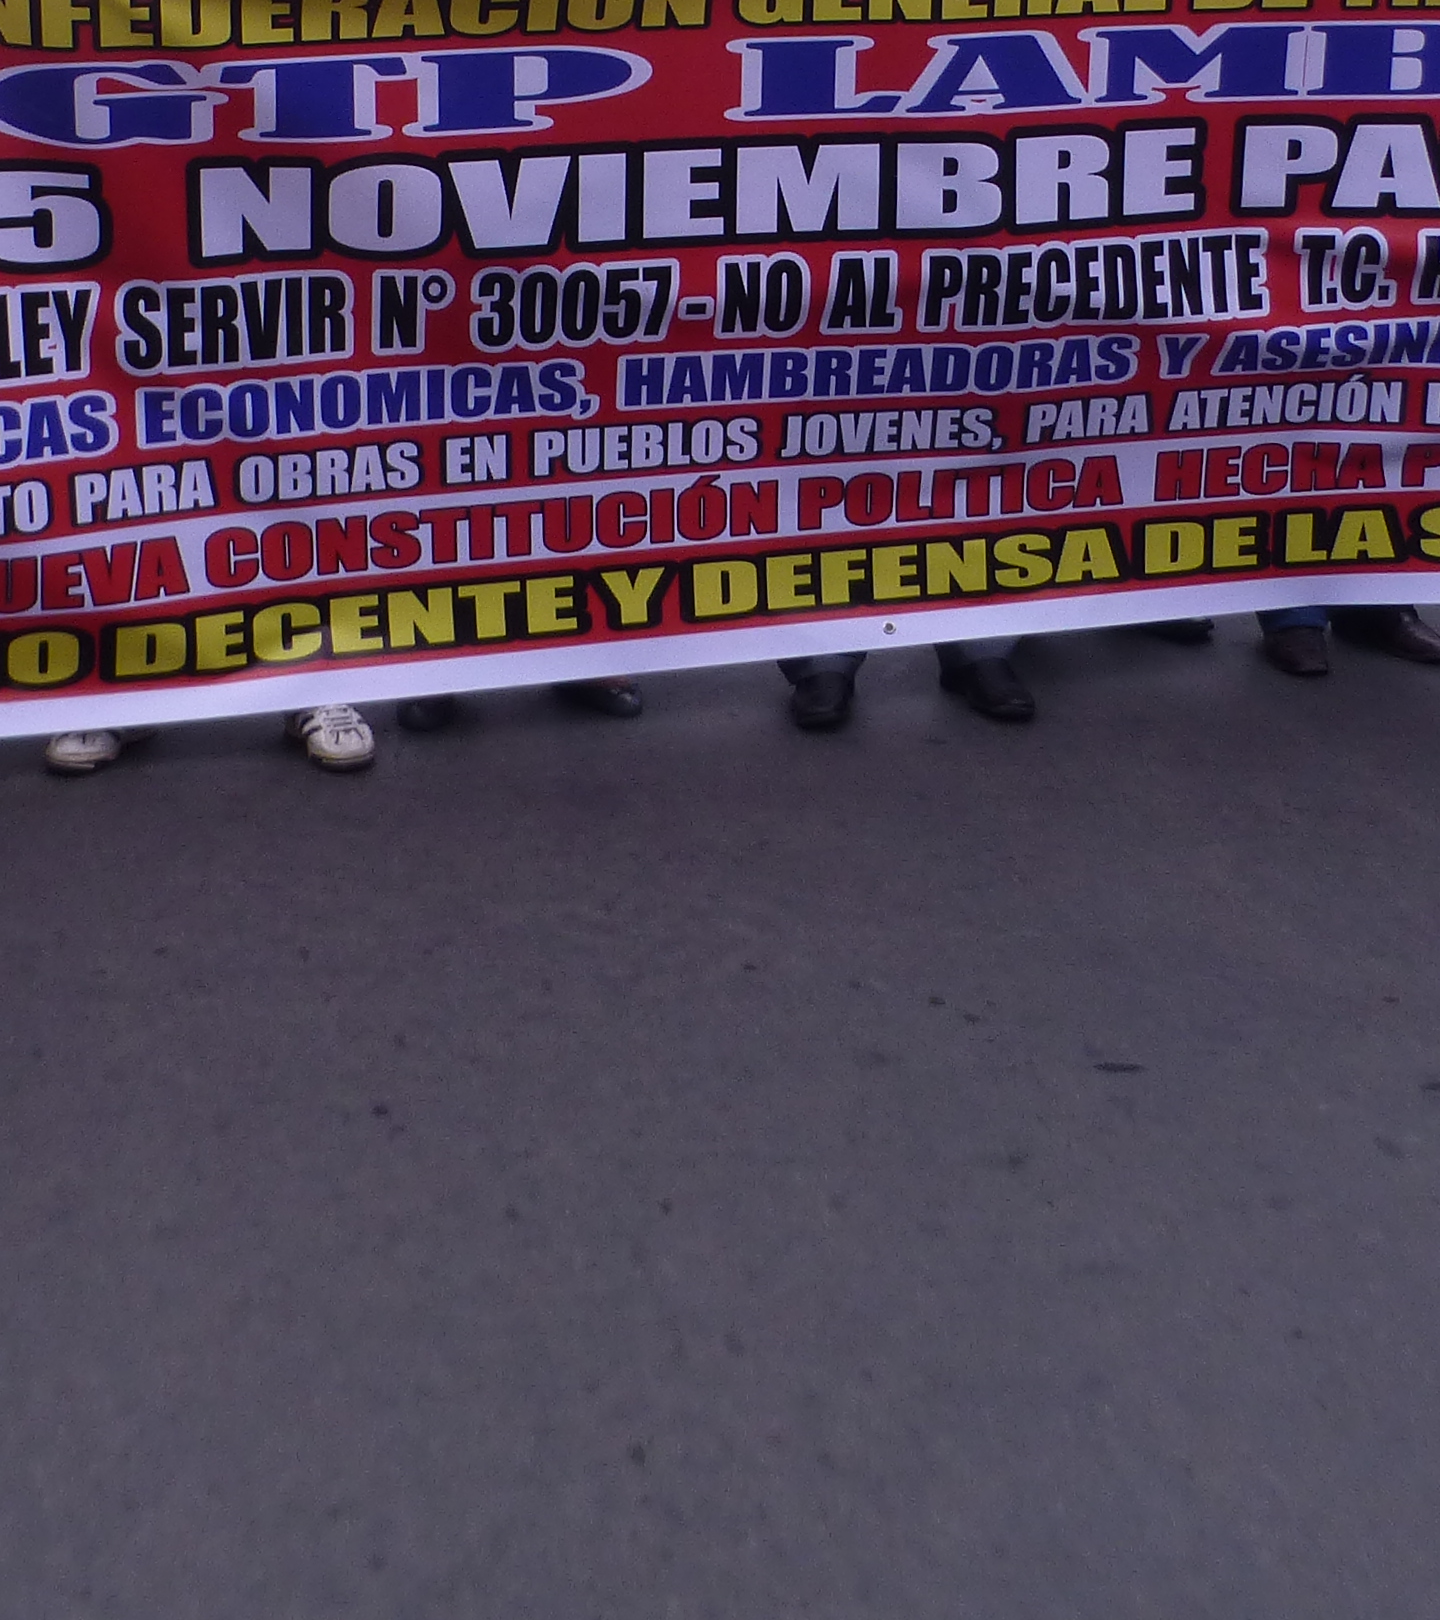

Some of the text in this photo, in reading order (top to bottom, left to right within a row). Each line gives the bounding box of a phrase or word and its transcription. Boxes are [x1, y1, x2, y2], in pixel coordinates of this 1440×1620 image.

[198, 126, 1196, 259] NOVIEMBRE
[123, 276, 348, 371] SERVIR
[828, 256, 896, 329] AL
[922, 234, 1264, 327] PRECEDENTE
[1300, 234, 1394, 305] T.C.
[74, 459, 216, 526] PARA
[238, 441, 420, 503] OBRAS
[445, 435, 508, 484] EN
[533, 417, 760, 476] PUEBLOS
[780, 405, 1004, 457] JOVENES,
[1025, 393, 1149, 444] PARA
[1168, 375, 1405, 432] ATENCIÓN
[144, 360, 598, 446] ECONOMICAS,
[623, 335, 1135, 407] HAMBREADORAS
[1160, 336, 1202, 377] Y
[203, 474, 778, 588] CONSTITUCIÓN
[797, 455, 1124, 532] POLITICA
[1153, 442, 1385, 503] HECHA
[114, 576, 578, 678] DECENTE
[601, 566, 666, 625] Y
[692, 527, 1121, 619] DEFENSA
[1144, 516, 1259, 575] DE
[1284, 508, 1396, 564] LA
